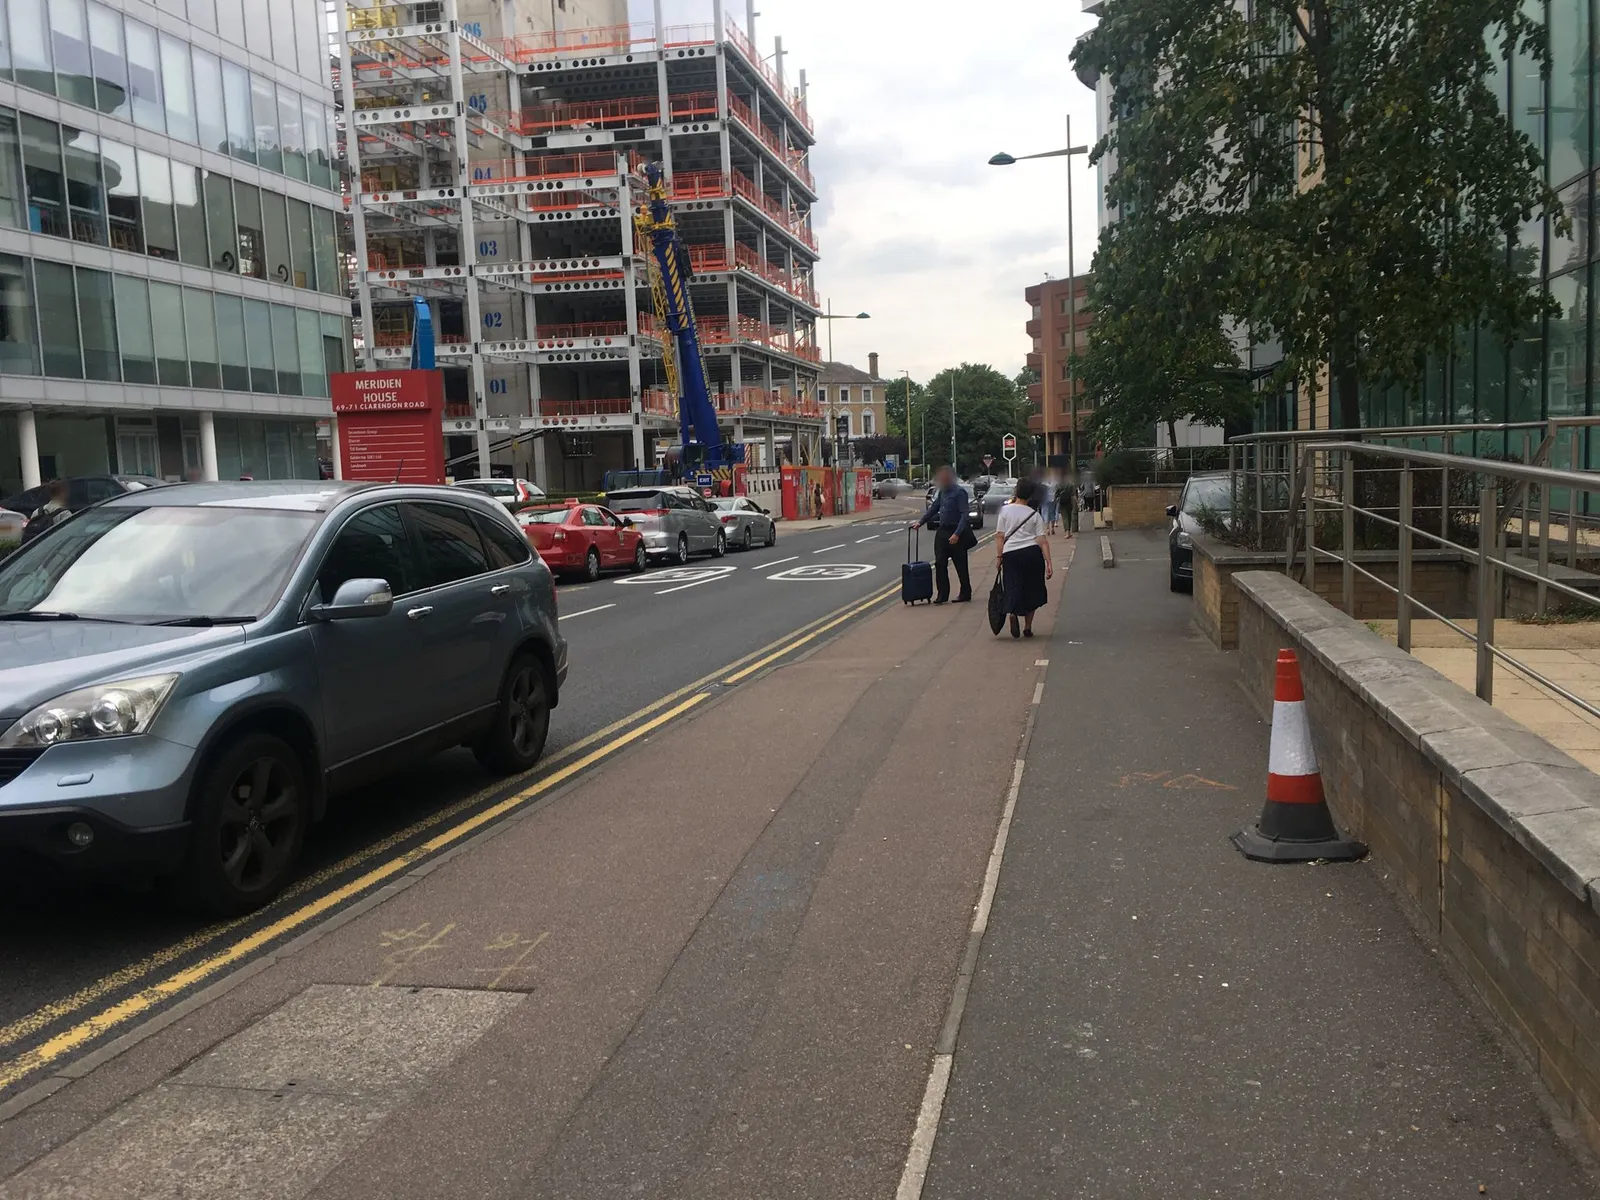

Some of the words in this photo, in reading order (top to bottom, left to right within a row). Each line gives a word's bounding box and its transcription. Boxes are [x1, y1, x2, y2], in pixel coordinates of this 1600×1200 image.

[463, 22, 482, 38] 06
[469, 94, 487, 114] 05
[473, 167, 493, 181] 04
[479, 240, 498, 257] 03
[484, 312, 503, 328] 02
[356, 379, 402, 390] MERIDIEN
[489, 379, 507, 394] 01
[364, 392, 398, 402] HOUSE
